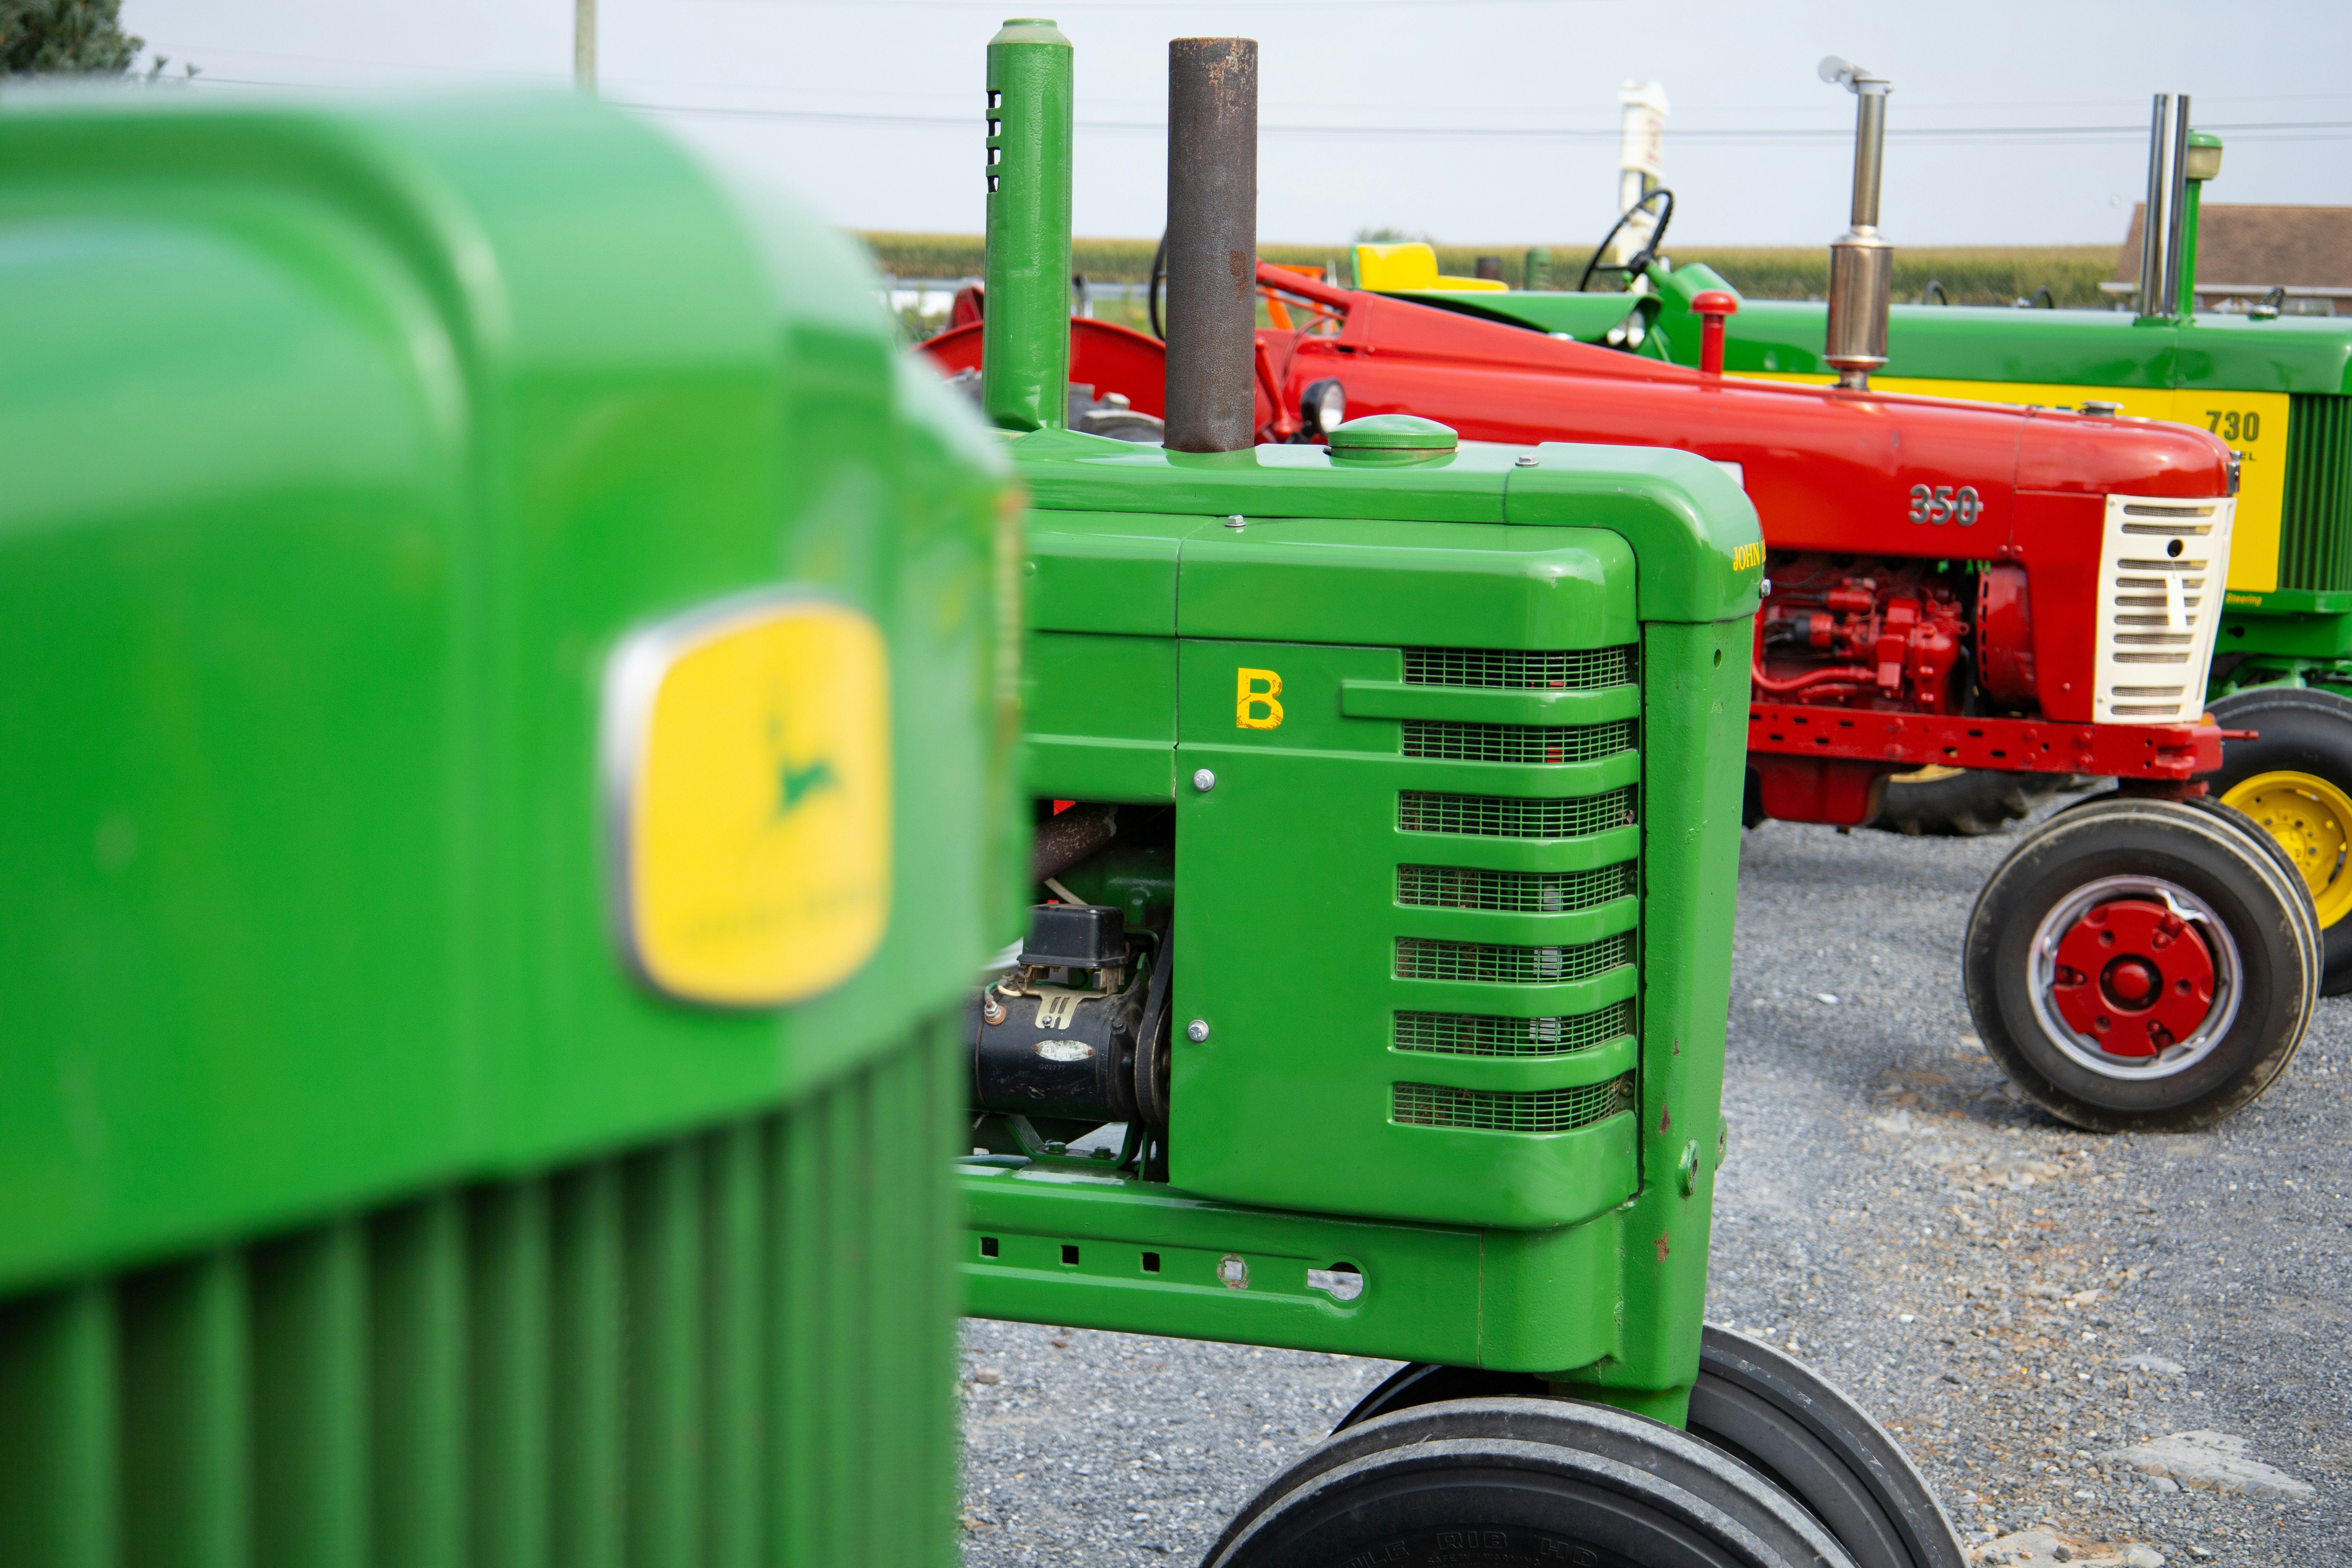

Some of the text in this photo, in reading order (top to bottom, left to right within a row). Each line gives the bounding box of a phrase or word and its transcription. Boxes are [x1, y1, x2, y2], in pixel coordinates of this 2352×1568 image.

[2206, 410, 2260, 441] 730
[1908, 484, 1980, 526] 350
[1733, 542, 1760, 571] JOHN
[1237, 668, 1283, 730] B
[1428, 1553, 1470, 1565] SAFETY
[1484, 1553, 1540, 1566] WARNING
[1437, 1531, 1507, 1550] RIB
[1541, 1537, 1598, 1566] HD
